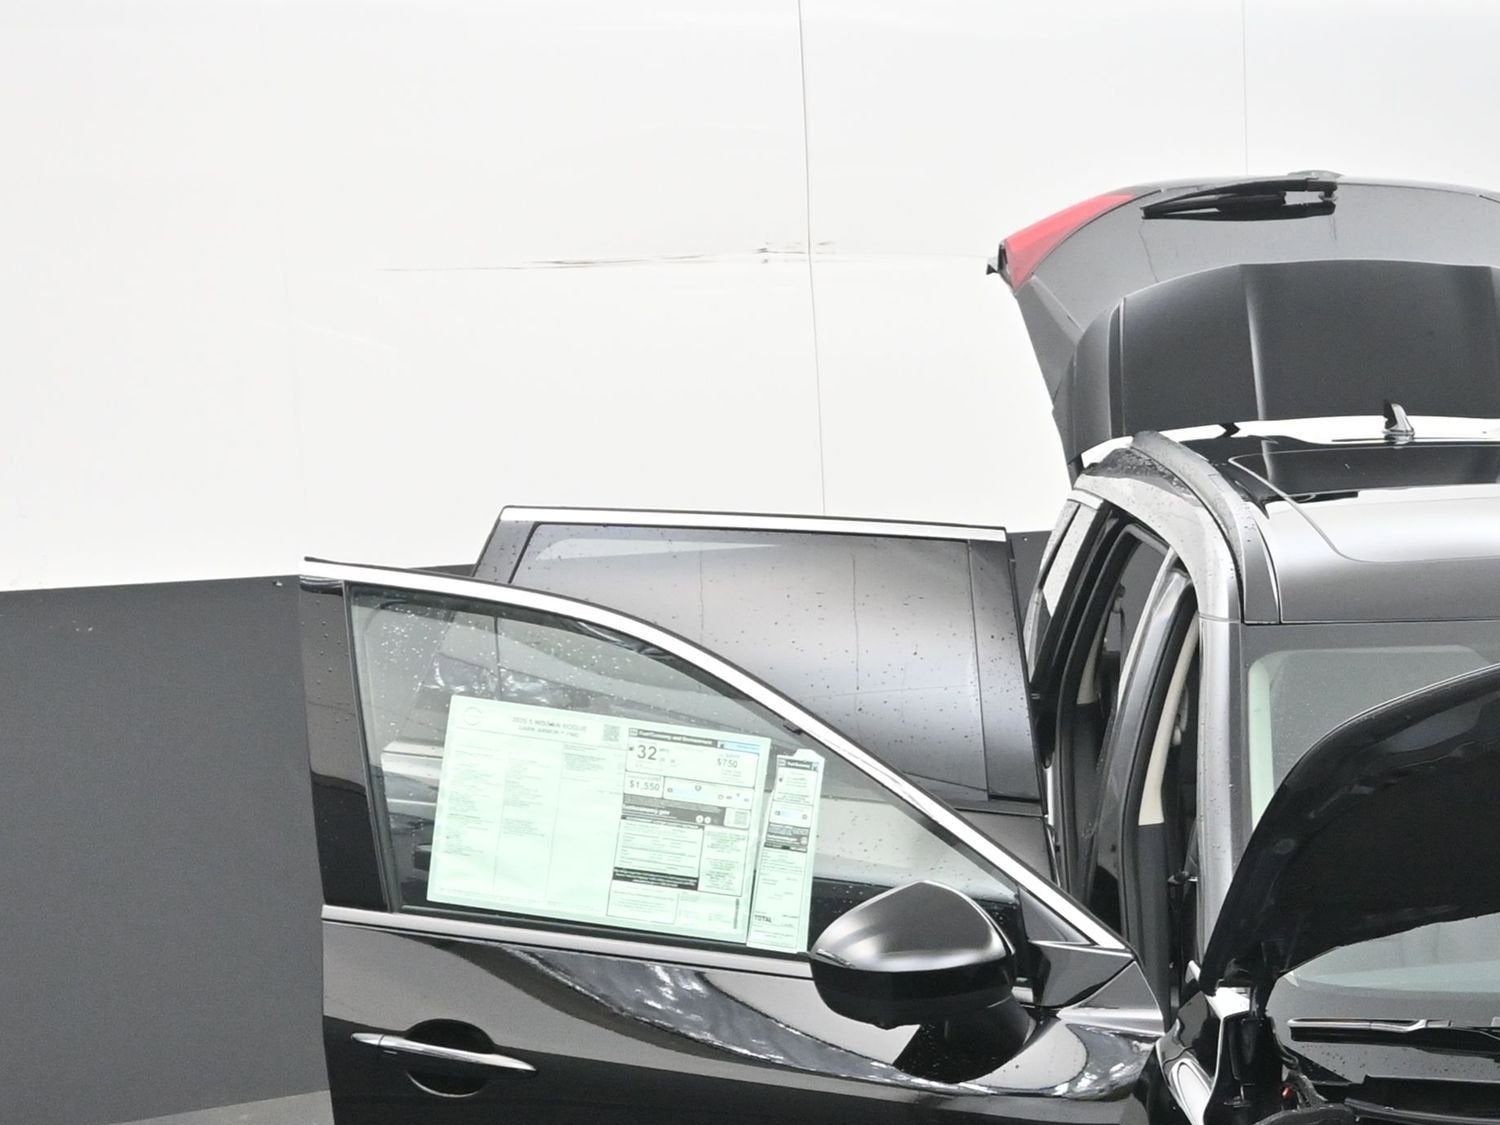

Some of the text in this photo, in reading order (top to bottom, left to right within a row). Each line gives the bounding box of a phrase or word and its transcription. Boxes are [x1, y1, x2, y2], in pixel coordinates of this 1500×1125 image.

[637, 744, 657, 761] 32
[717, 757, 738, 769] $750
[629, 779, 660, 793] $1,550
